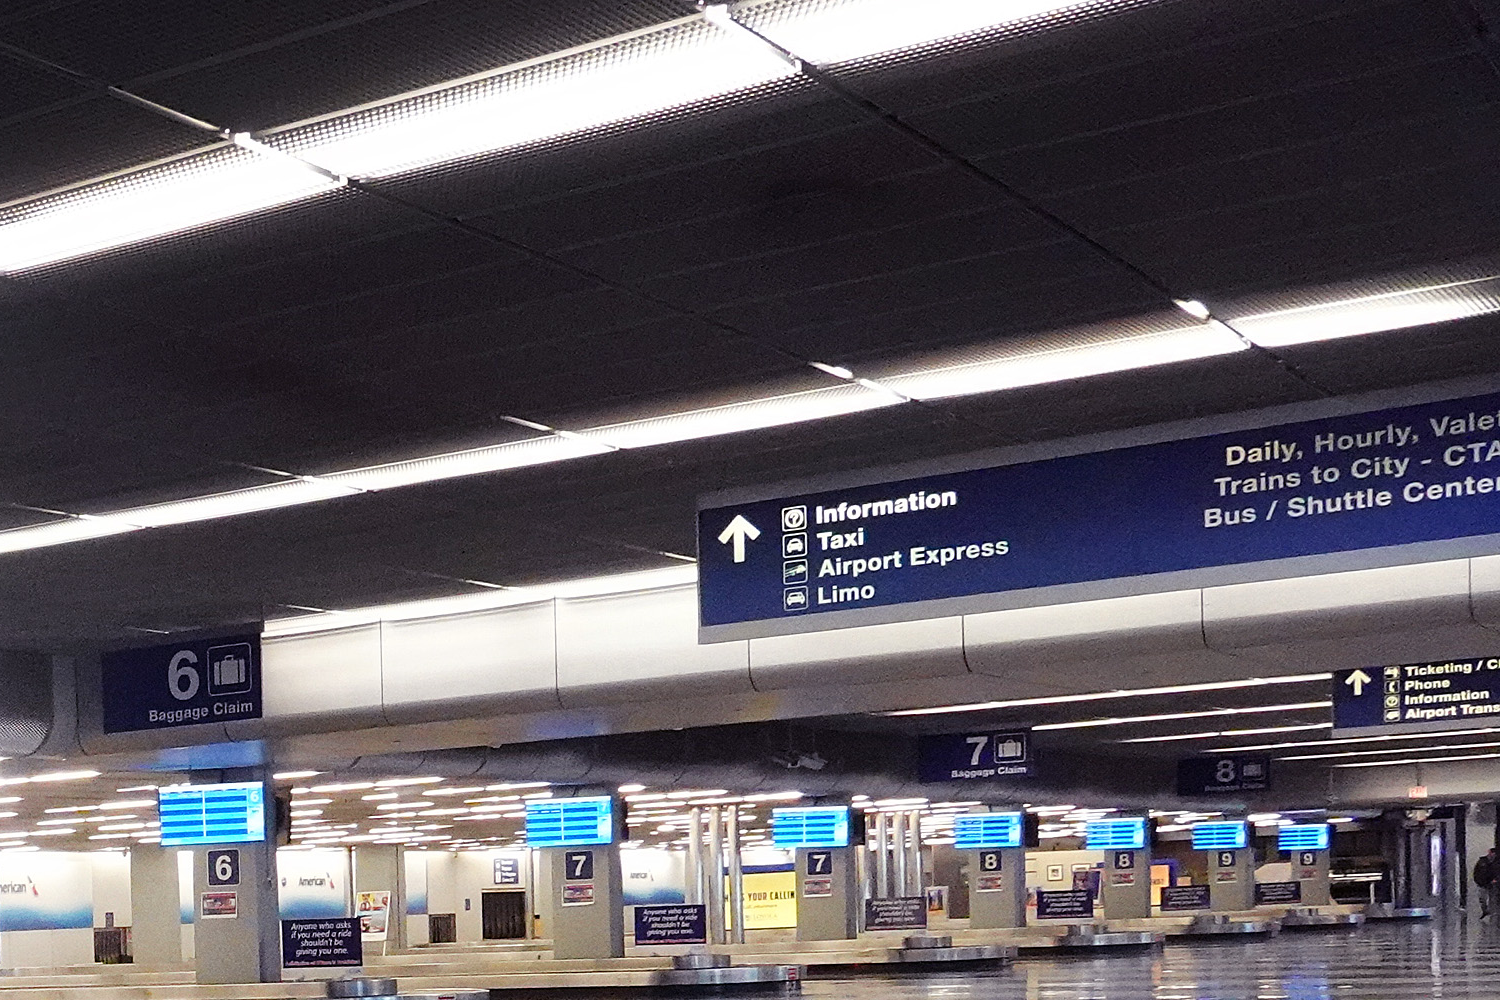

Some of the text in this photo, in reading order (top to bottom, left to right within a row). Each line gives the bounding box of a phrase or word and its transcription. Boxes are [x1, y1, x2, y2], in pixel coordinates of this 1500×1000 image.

[1226, 440, 1303, 466] Daily,
[1315, 424, 1419, 453] Hourly,
[1214, 472, 1300, 496] Trains
[1311, 466, 1340, 485] to
[1351, 455, 1410, 479] City
[1443, 440, 1500, 467] CTA
[816, 491, 957, 524] Information
[1204, 505, 1257, 528] Bus
[1266, 500, 1278, 521] /
[1287, 488, 1392, 518] Shuttle
[817, 527, 865, 551] Taxi
[818, 540, 1009, 578] Airport Express
[818, 583, 875, 605] Limo
[168, 650, 199, 700] 6
[1405, 658, 1500, 676] Ticketing / C
[1405, 679, 1450, 691] Phone
[1405, 690, 1490, 705] Information
[149, 701, 253, 723] Baggage Claim
[1405, 704, 1500, 719] Airport Trans
[966, 736, 988, 765] 7
[998, 766, 1026, 775] Claim
[1217, 760, 1235, 783] 8
[250, 790, 260, 802] 6
[572, 855, 587, 876] 7
[813, 855, 826, 872] 7
[985, 854, 997, 869] 8
[1119, 854, 1131, 867] 8
[1222, 853, 1233, 866] 9
[1303, 853, 1313, 864] 9
[215, 855, 233, 881] 6
[747, 892, 767, 901] YOUR
[769, 891, 795, 900] CALLIN
[291, 923, 317, 931] Anyone
[335, 921, 351, 929] asks
[291, 931, 297, 939] if
[311, 930, 330, 938] need
[334, 938, 344, 946] be
[296, 948, 317, 957] giving
[318, 948, 332, 956] you
